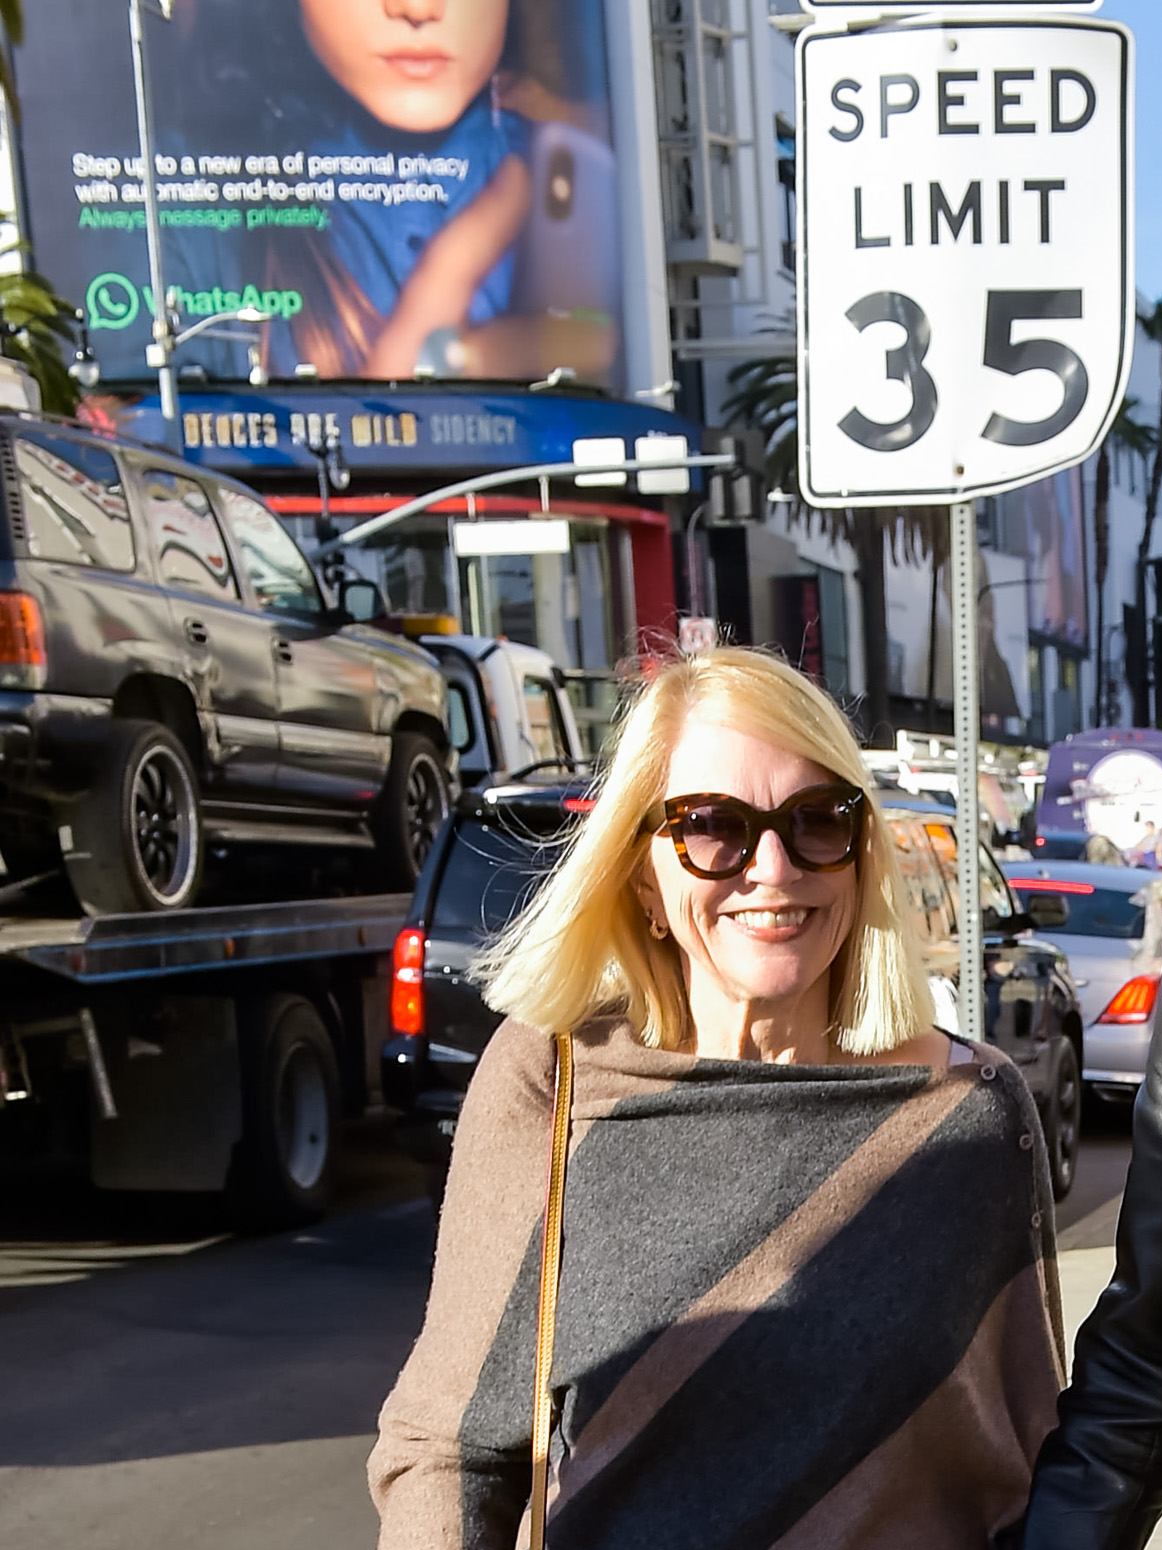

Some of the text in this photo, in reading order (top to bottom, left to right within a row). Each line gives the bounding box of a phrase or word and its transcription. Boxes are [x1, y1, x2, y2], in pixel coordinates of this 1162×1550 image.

[828, 69, 1097, 142] SPEED
[72, 153, 121, 179] Step
[155, 152, 178, 176] to
[180, 155, 196, 175] a
[199, 155, 242, 175] new
[245, 155, 279, 175] era
[282, 151, 304, 175] of
[308, 152, 394, 179] personal
[398, 153, 469, 182] privacy
[74, 178, 449, 206] with aumatic end-to-end encryption.
[854, 179, 1066, 249] LIMIT
[837, 288, 1089, 452] 35
